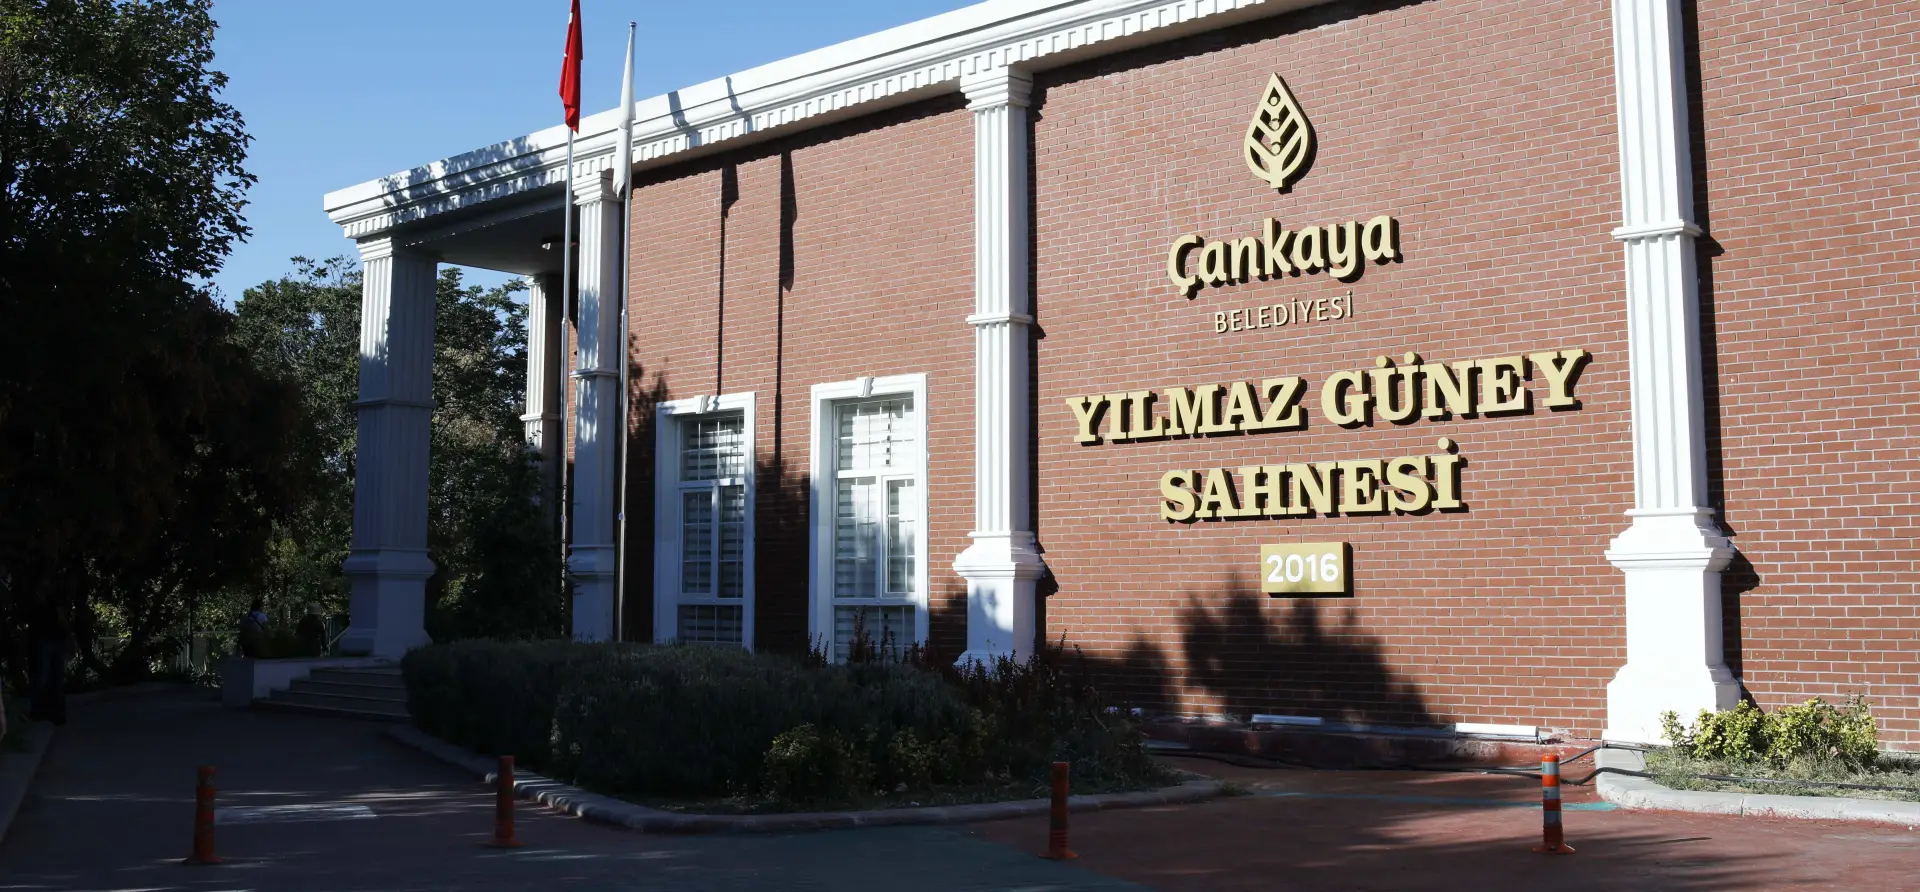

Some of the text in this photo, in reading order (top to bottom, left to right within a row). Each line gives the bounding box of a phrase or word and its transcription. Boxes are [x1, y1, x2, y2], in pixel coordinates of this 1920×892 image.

[1167, 214, 1398, 297] Çankaya
[1214, 290, 1353, 333] BELEDİYESİ
[1065, 348, 1587, 443] YILMAZ GÜNEY
[1160, 436, 1463, 521] SAHNESİ
[1266, 552, 1339, 583] 2016
